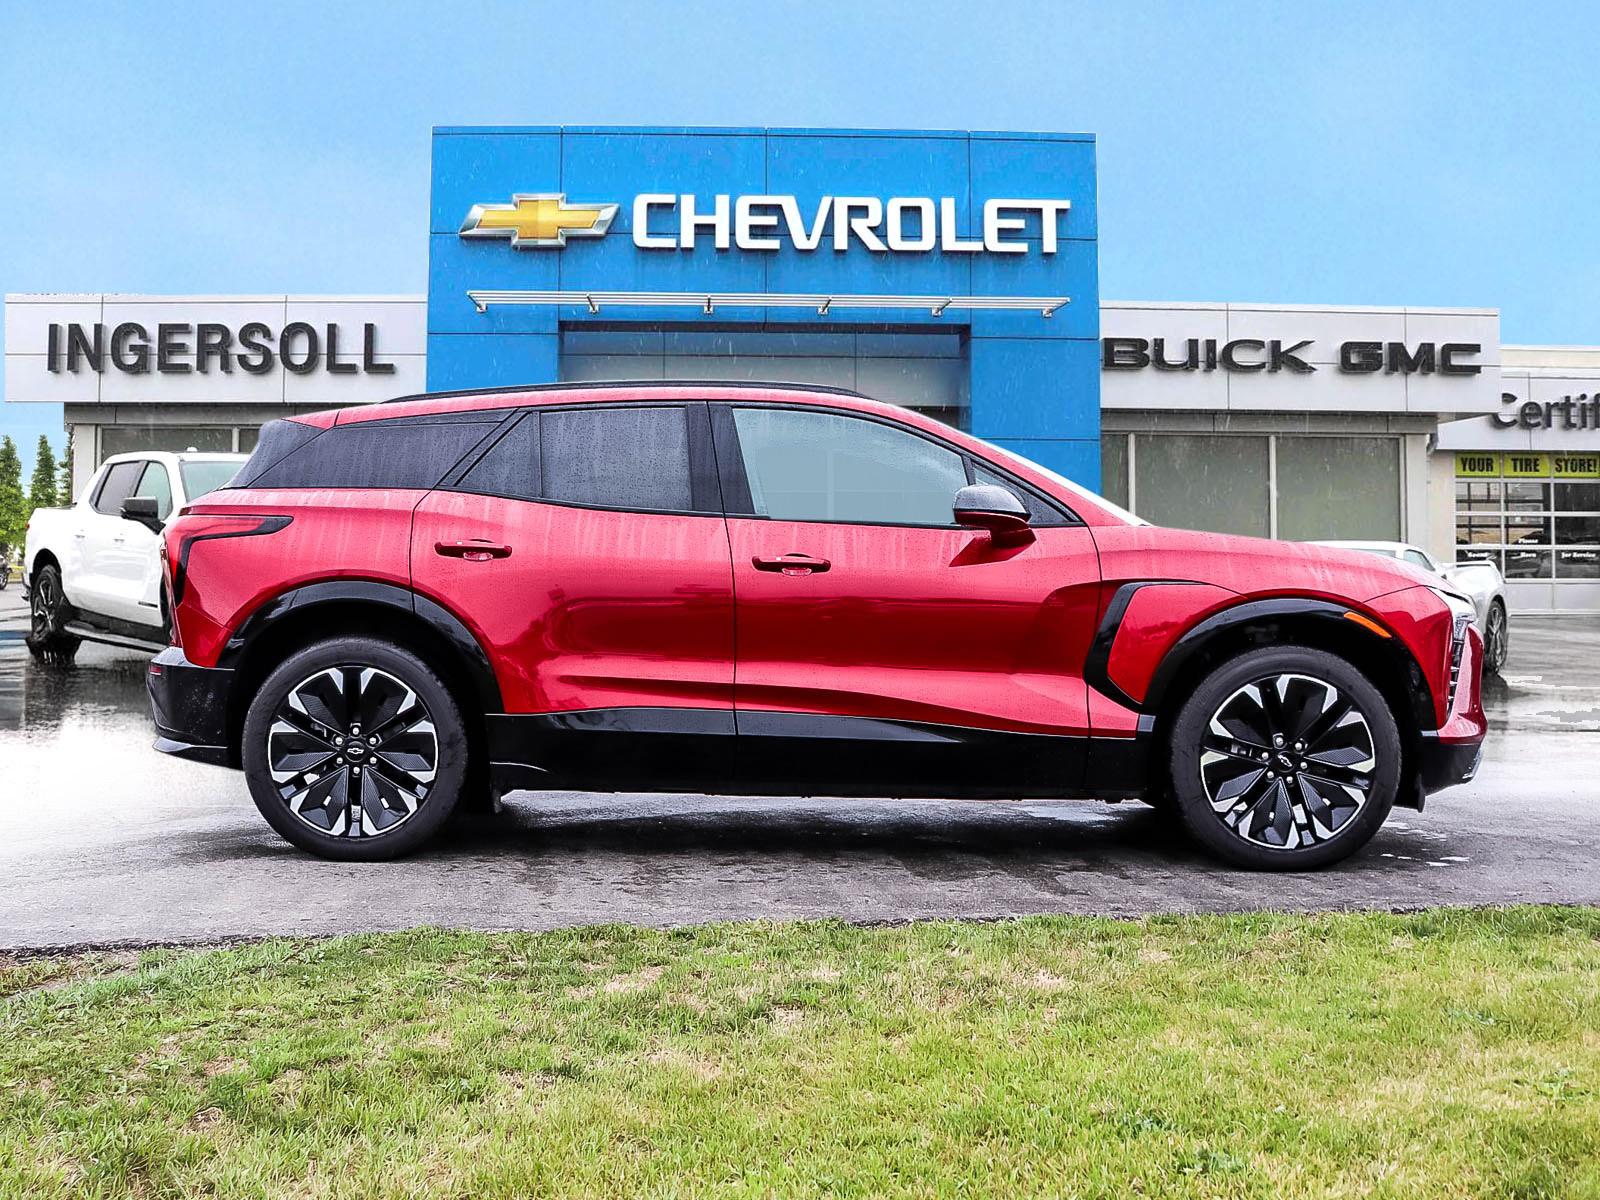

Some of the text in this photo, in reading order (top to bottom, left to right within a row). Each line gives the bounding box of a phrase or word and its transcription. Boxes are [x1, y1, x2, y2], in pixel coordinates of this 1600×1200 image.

[632, 193, 1071, 254] CHEVROLET
[47, 322, 395, 374] INGERSOLL
[1103, 337, 1482, 374] BUICK GMC
[1460, 457, 1598, 473] YOUR TIRE STORE!
